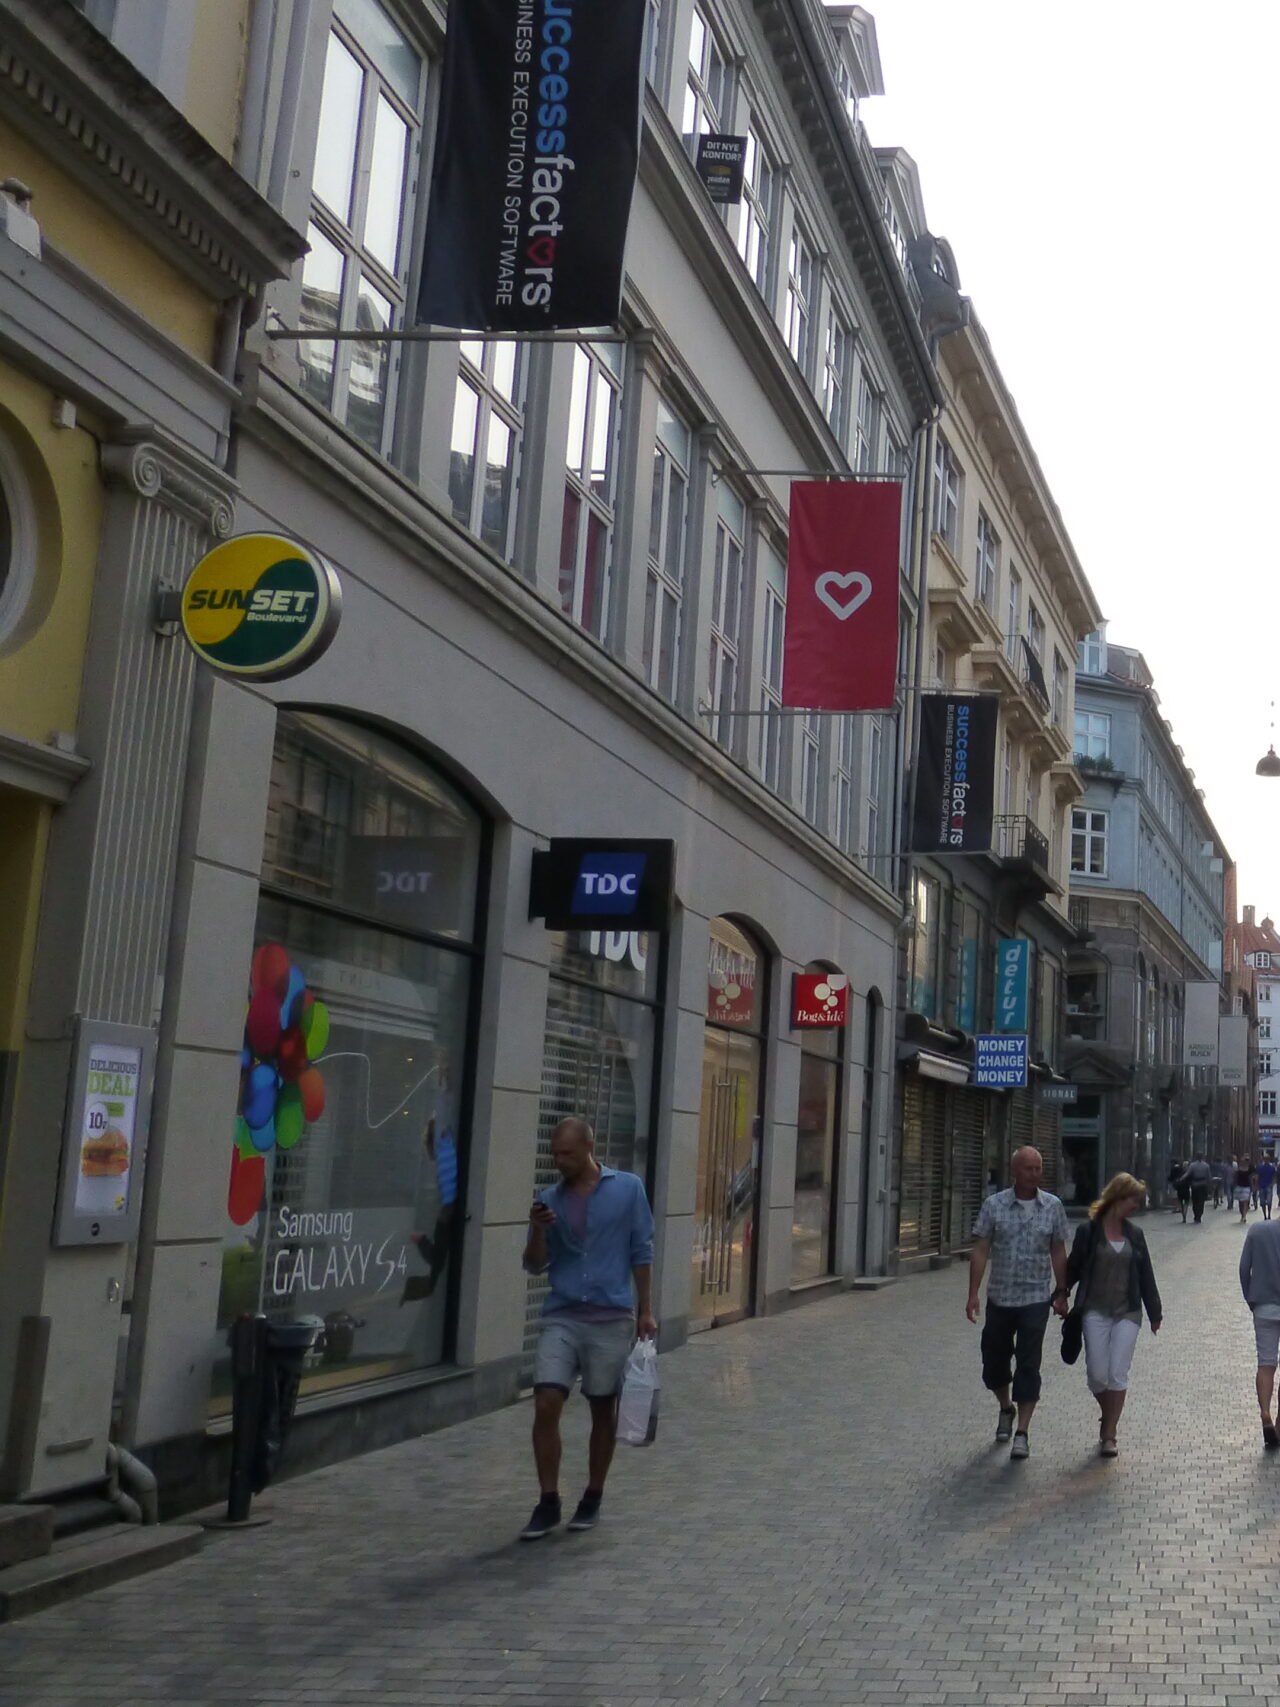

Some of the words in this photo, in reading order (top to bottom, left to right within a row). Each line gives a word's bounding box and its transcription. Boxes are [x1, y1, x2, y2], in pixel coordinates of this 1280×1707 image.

[506, 71, 530, 189] EXECUTION
[707, 141, 721, 151] DIT
[722, 143, 740, 152] NYE
[495, 195, 522, 307] SOFTWARE
[187, 589, 315, 613] SUNSET
[246, 612, 308, 623] Boulevard
[942, 747, 953, 797] EXECUTION
[939, 798, 950, 844] SOFTWARE
[580, 872, 637, 895] TDC
[1002, 944, 1021, 1025] detur
[978, 1040, 1024, 1052] MONEY
[90, 1059, 137, 1074] DELICIOUS
[978, 1055, 1024, 1067] CHANGE
[86, 1071, 135, 1097] DEAL
[977, 1070, 1024, 1082] MONEY
[277, 1205, 353, 1242] Samsung
[272, 1243, 373, 1295] GALAXY
